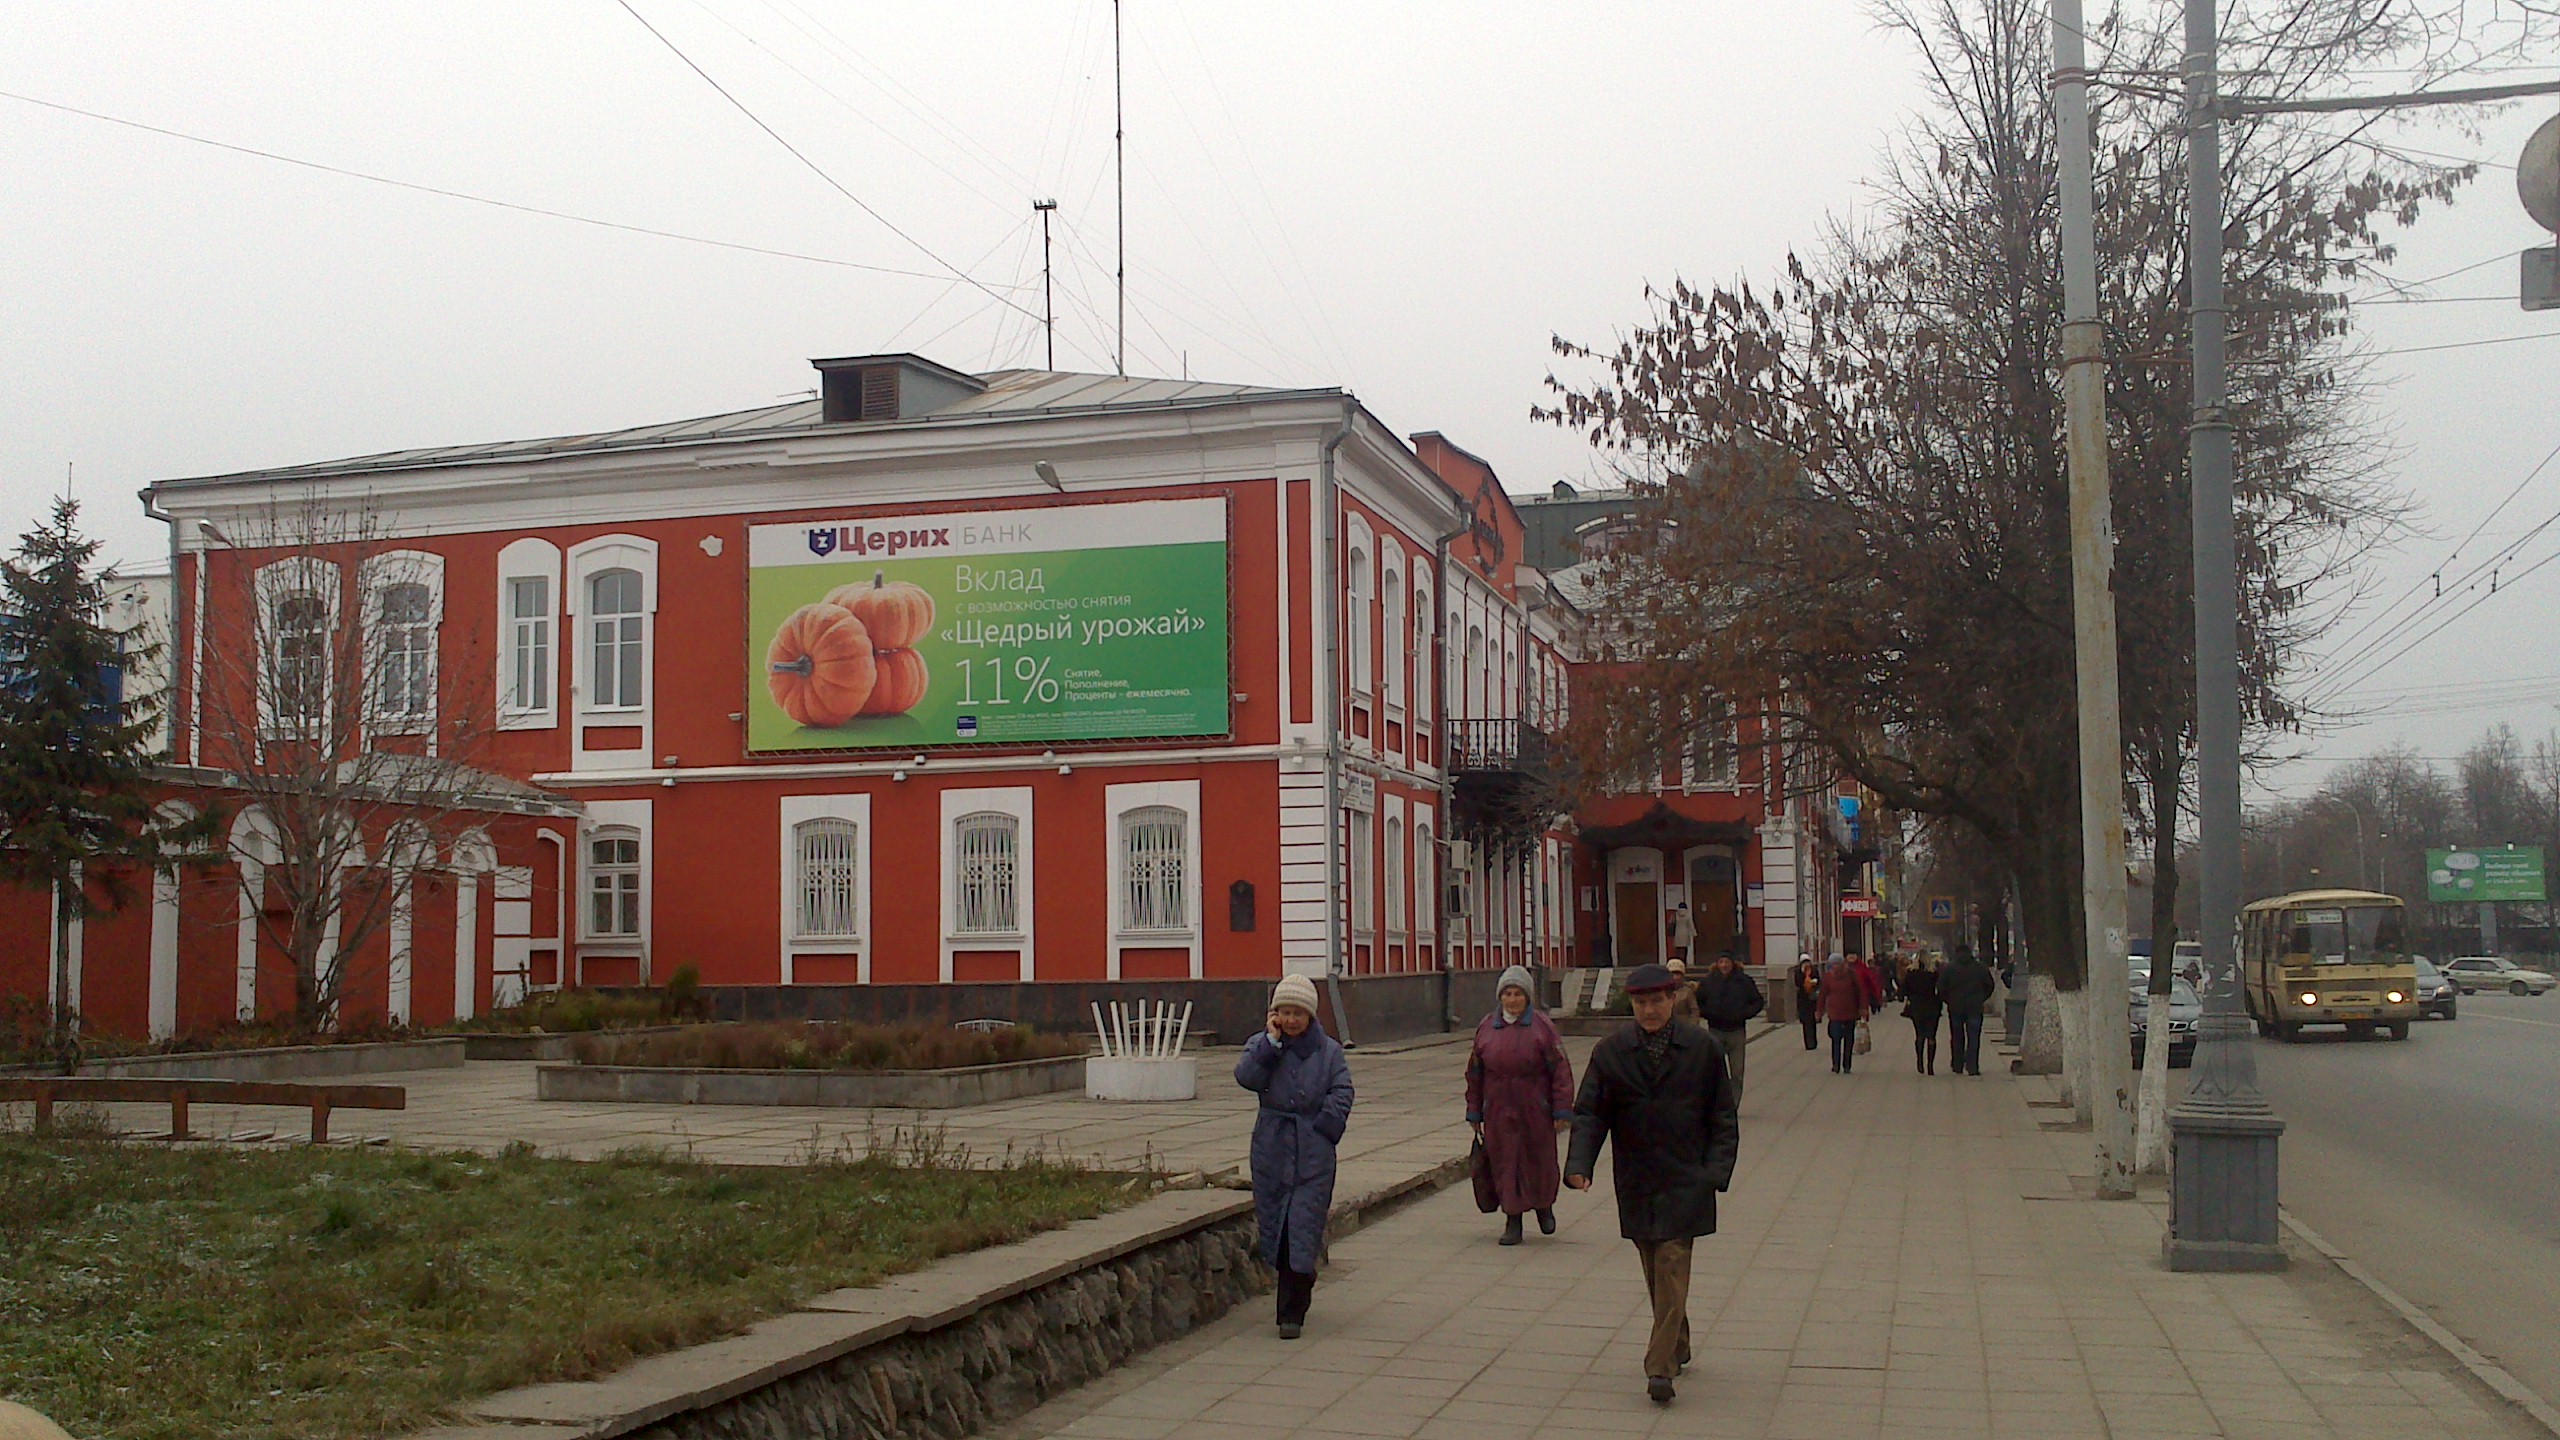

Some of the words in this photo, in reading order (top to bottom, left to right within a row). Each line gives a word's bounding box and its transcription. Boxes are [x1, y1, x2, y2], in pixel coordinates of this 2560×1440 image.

[840, 526, 950, 556] Церих
[963, 523, 1032, 545] БАНК
[956, 564, 1045, 594] Вклад
[956, 603, 963, 614] с
[968, 598, 1078, 615] возможностью
[1082, 595, 1132, 609] снятия
[941, 614, 1073, 648] «Щедрый
[1082, 608, 1206, 646] урожай»
[956, 656, 1060, 706] 11%
[1064, 668, 1102, 679] Снятие,
[1064, 679, 1130, 690] Пополнение,
[1064, 690, 1117, 701] Проценты
[1126, 688, 1192, 699] ежемесячно.
